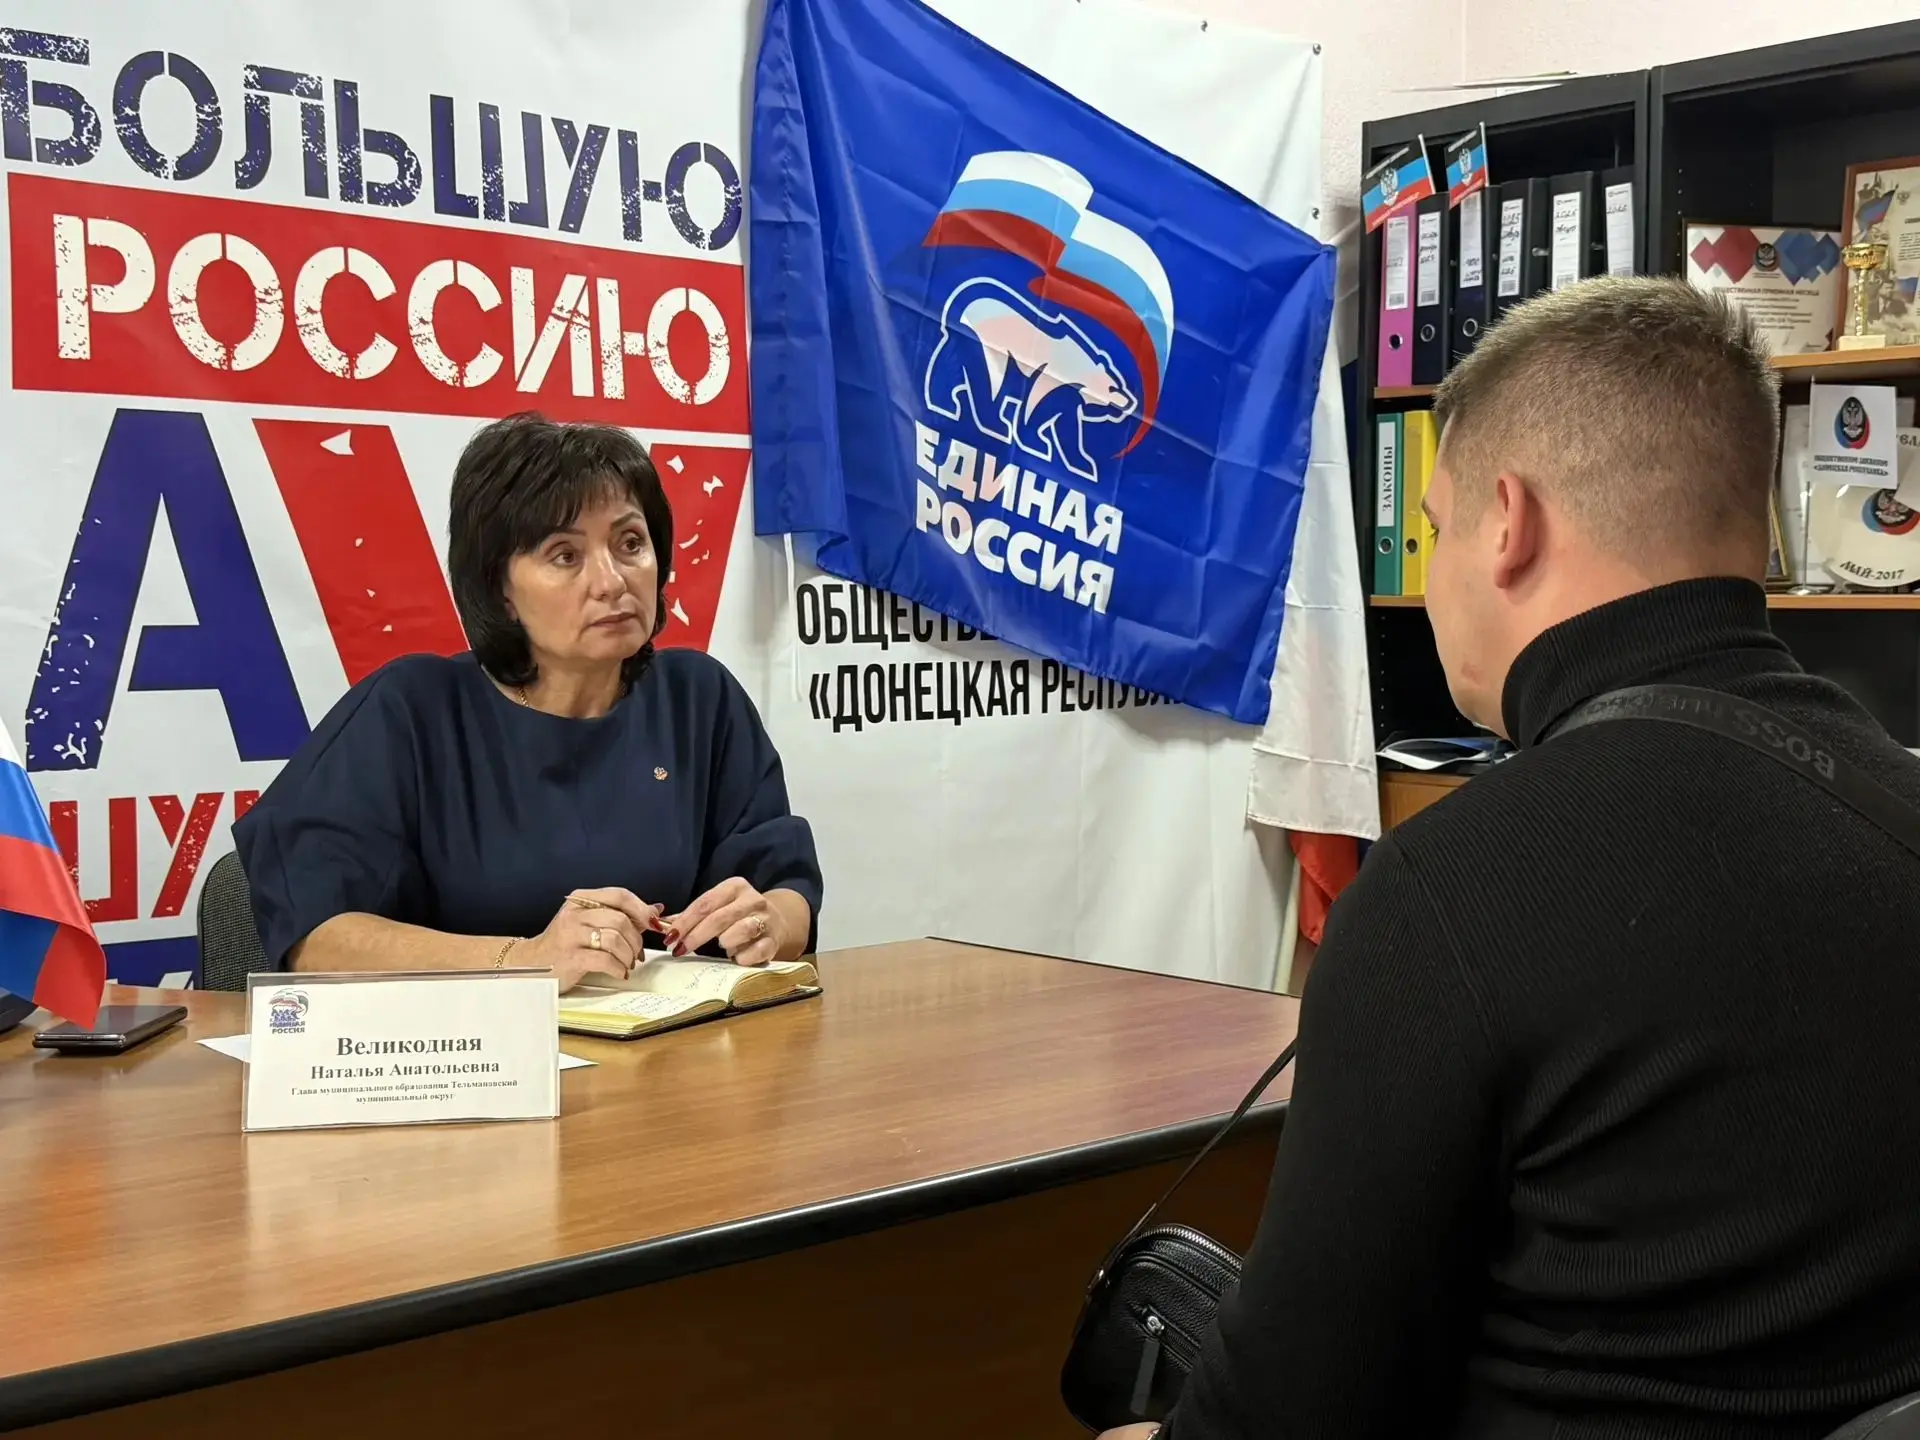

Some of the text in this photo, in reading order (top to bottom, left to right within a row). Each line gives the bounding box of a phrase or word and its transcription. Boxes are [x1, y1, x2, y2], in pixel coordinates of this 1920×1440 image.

[0, 26, 743, 251] БОЛЬШУЮ
[52, 213, 731, 406] РОССИЮ
[915, 420, 1124, 556] ЕДИНАЯ
[1382, 446, 1393, 512] ЗАКОНЫ
[916, 479, 1116, 615] РОССИЯ
[808, 659, 1031, 732] «ДОНЕЦКАЯ
[1732, 709, 1836, 781] BOSS
[272, 1027, 305, 1035] РОССИЯ
[336, 1037, 482, 1056] Великодная
[291, 1087, 318, 1096] Глава
[311, 1062, 500, 1081] Наталья Анатольевна
